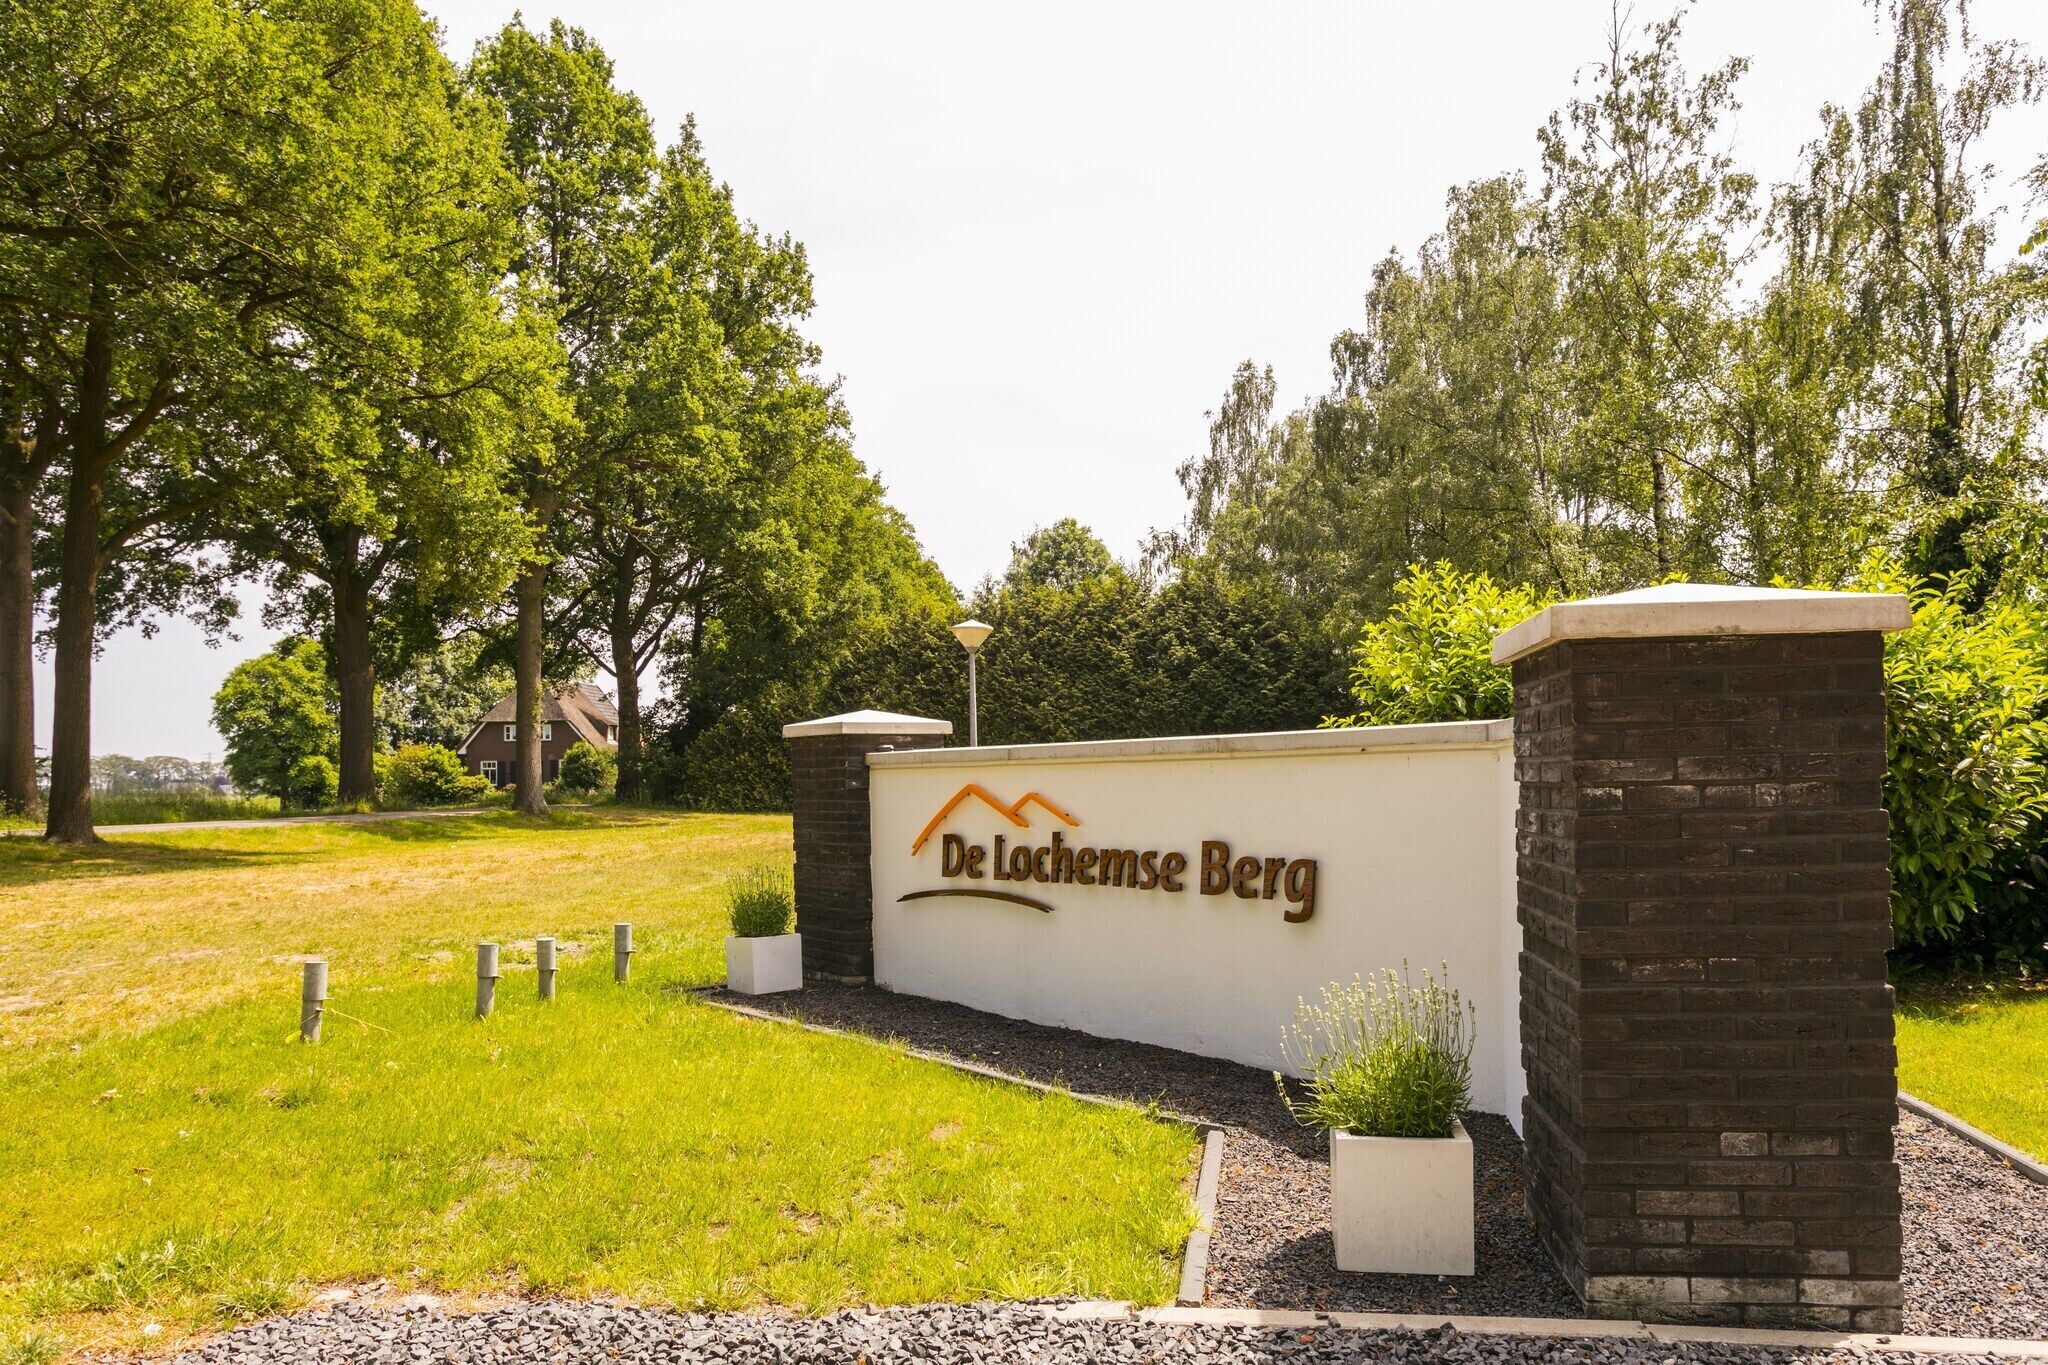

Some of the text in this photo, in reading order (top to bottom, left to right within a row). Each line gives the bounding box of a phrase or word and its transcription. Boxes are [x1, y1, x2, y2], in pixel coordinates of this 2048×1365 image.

[941, 831, 1317, 923] De Lochemse Berg
